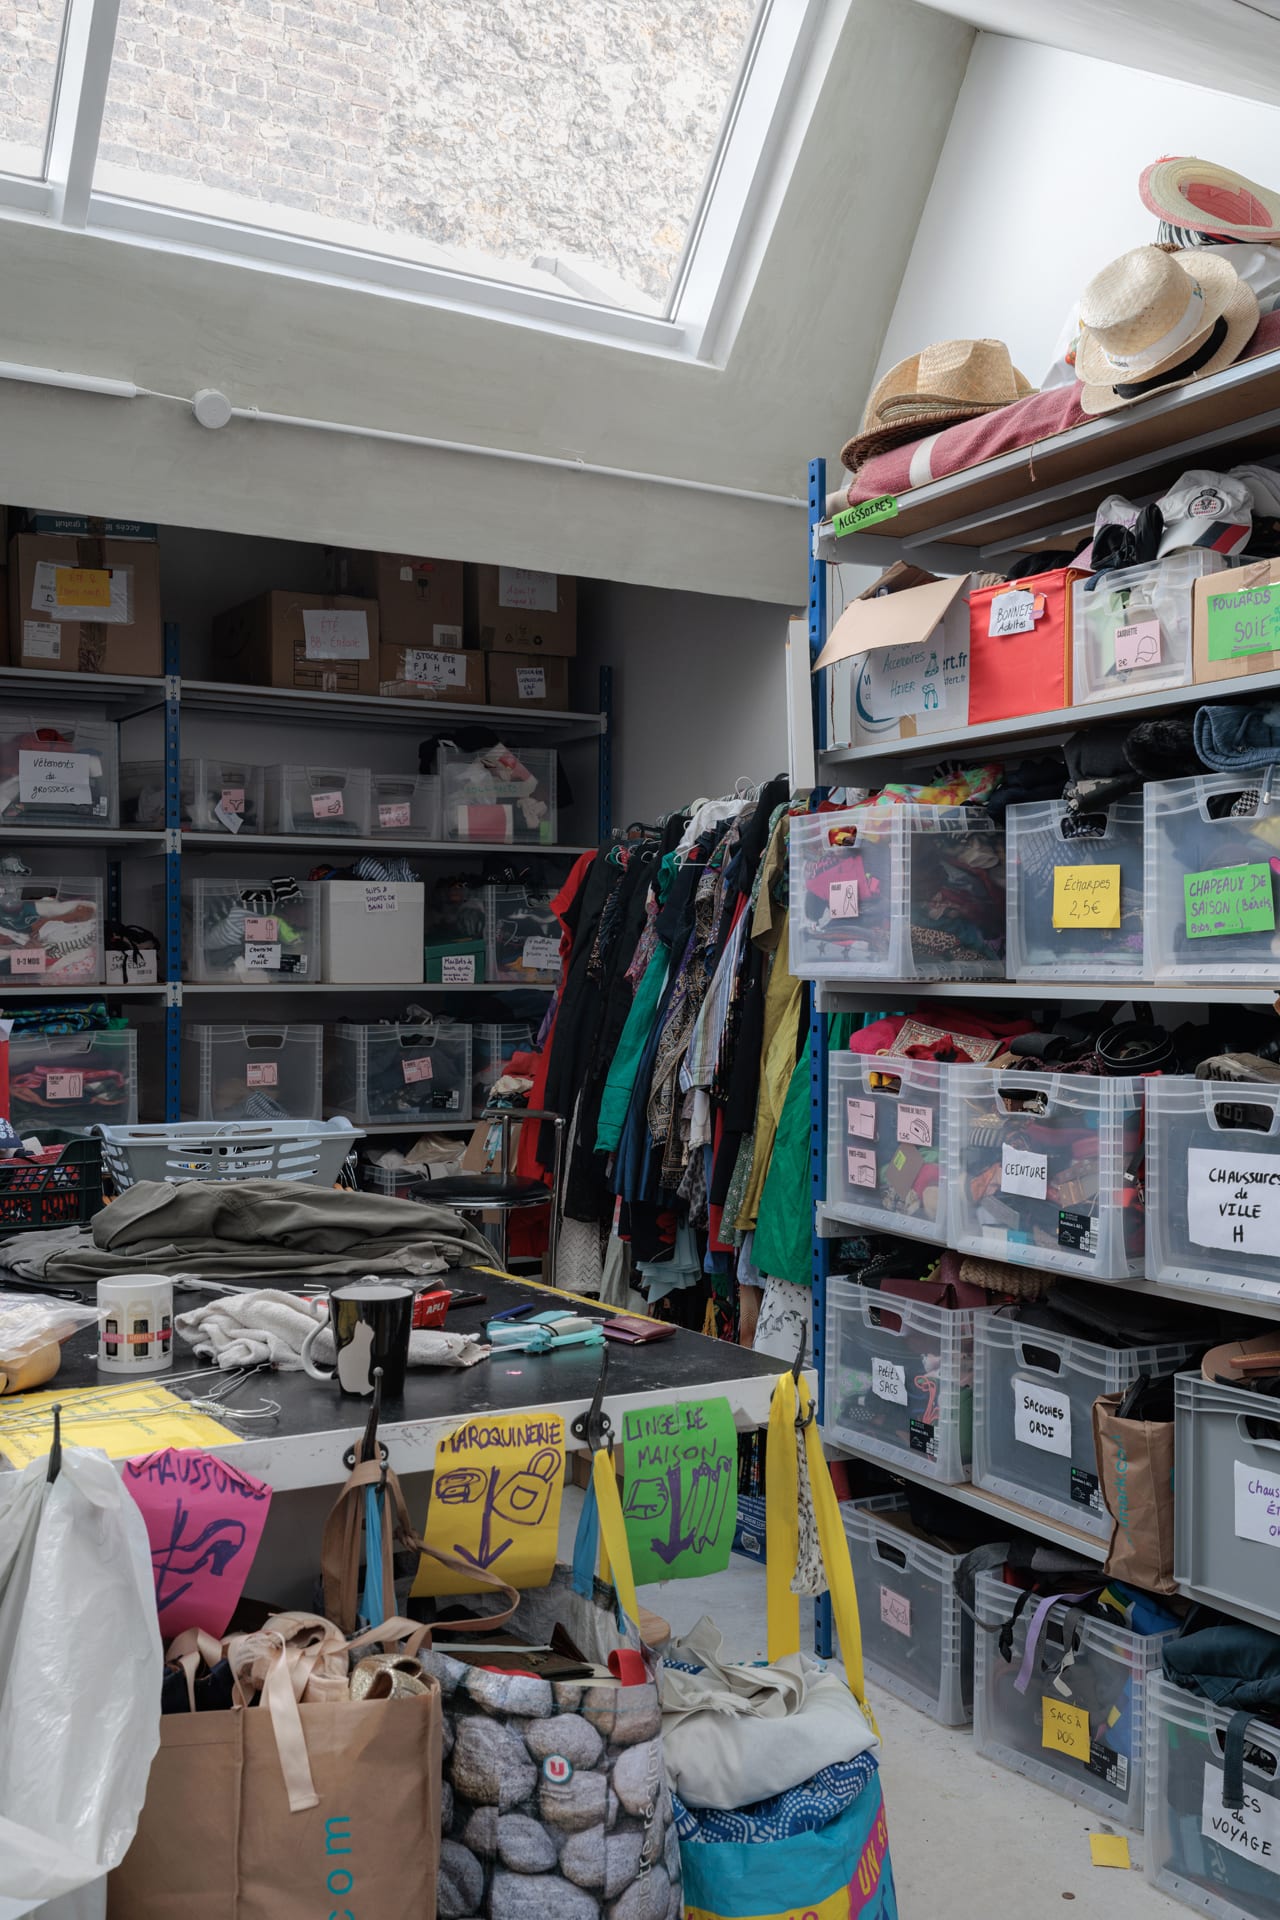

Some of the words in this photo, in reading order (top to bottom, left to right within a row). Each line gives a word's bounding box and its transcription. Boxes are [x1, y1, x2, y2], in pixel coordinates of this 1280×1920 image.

[839, 498, 893, 531] ACCESSOIRES
[1213, 589, 1272, 613] FOULARDS
[998, 619, 1026, 633] Adultes
[1234, 614, 1272, 643] SOIE
[415, 652, 439, 664] STOCK
[433, 663, 440, 672] H
[33, 757, 75, 769] Vêtements
[31, 785, 75, 800] grossesse
[1063, 874, 1111, 895] Écharpes
[1189, 877, 1245, 897] CHAPEAUX
[1250, 874, 1266, 893] DE
[368, 903, 384, 911] BAIN
[1069, 899, 1101, 920] 2,5€
[1191, 899, 1231, 917] SAISON
[1005, 1163, 1046, 1180] CEINTURE
[1219, 1202, 1262, 1219] VILLE
[1233, 1224, 1244, 1243] H
[426, 1301, 445, 1315] APLI
[879, 1380, 899, 1395] SACS
[1023, 1395, 1065, 1420] SACOCHES
[625, 1413, 681, 1441] LINGE
[686, 1407, 708, 1431] DE
[1029, 1420, 1055, 1438] ORDI
[638, 1437, 717, 1469] MAISON
[127, 1452, 267, 1501] CHAUSSUR
[1050, 1707, 1073, 1725] SACS
[1057, 1729, 1075, 1746] DOS
[1243, 1794, 1261, 1813] CS
[1212, 1816, 1273, 1856] VOYAGE
[859, 1839, 881, 1897] UN
